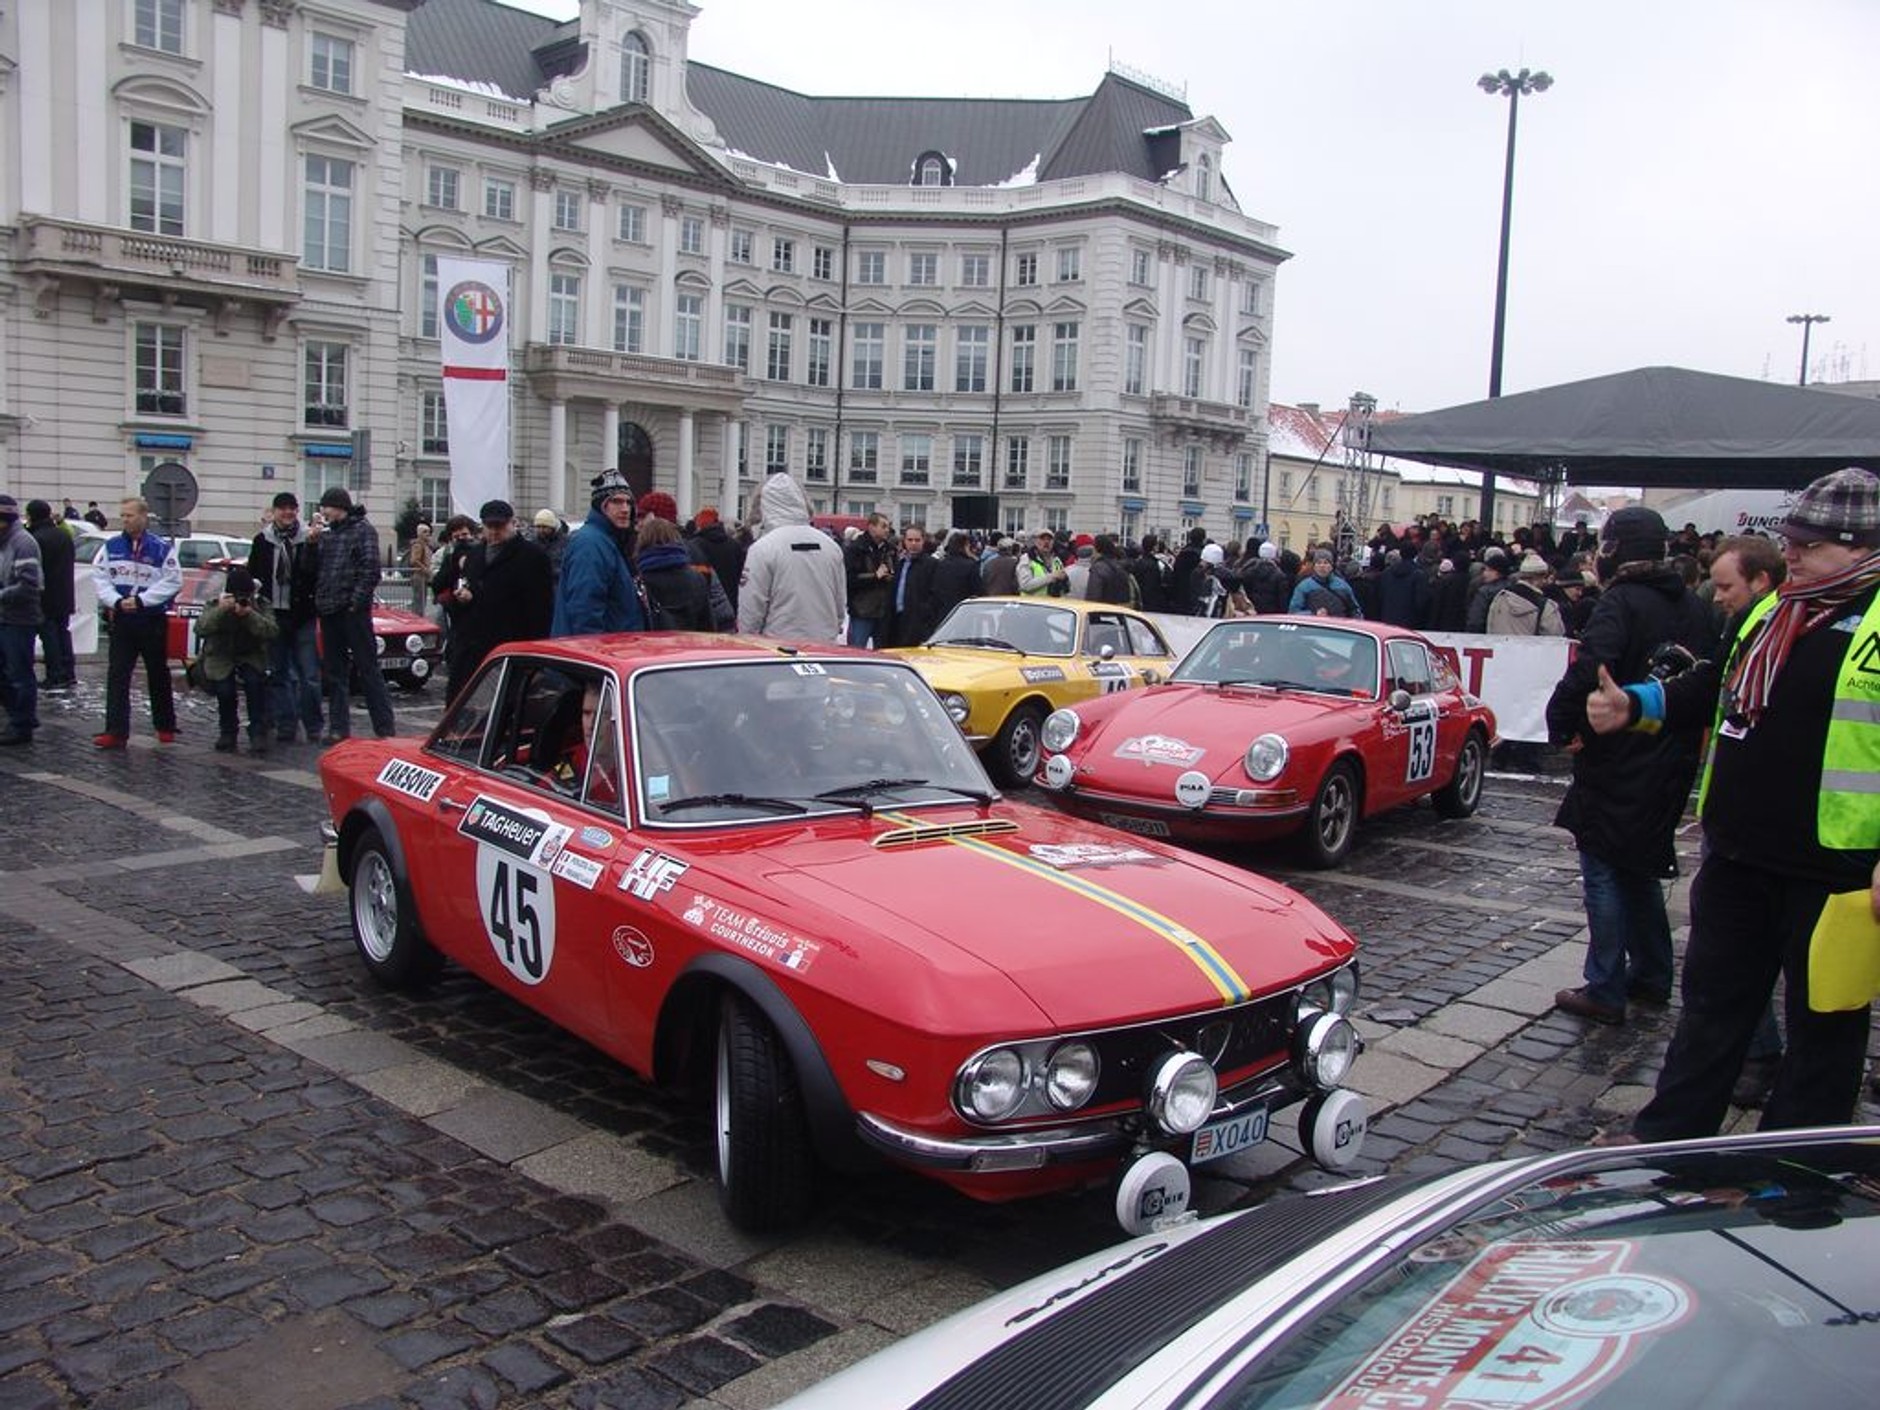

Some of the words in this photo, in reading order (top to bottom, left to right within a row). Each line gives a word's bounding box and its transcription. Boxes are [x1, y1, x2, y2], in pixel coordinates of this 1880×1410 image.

[1410, 723, 1434, 780] 53
[382, 760, 441, 799] VARSOVIE
[1179, 783, 1204, 791] PIAA
[616, 848, 690, 901] HF
[490, 859, 543, 979] 45
[712, 904, 747, 930] TEAM
[710, 922, 776, 959] COURTHEZON
[1464, 1246, 1615, 1317] RALLYE
[1344, 1302, 1459, 1398] HISTORIQUE
[1477, 1344, 1564, 1384] 41
